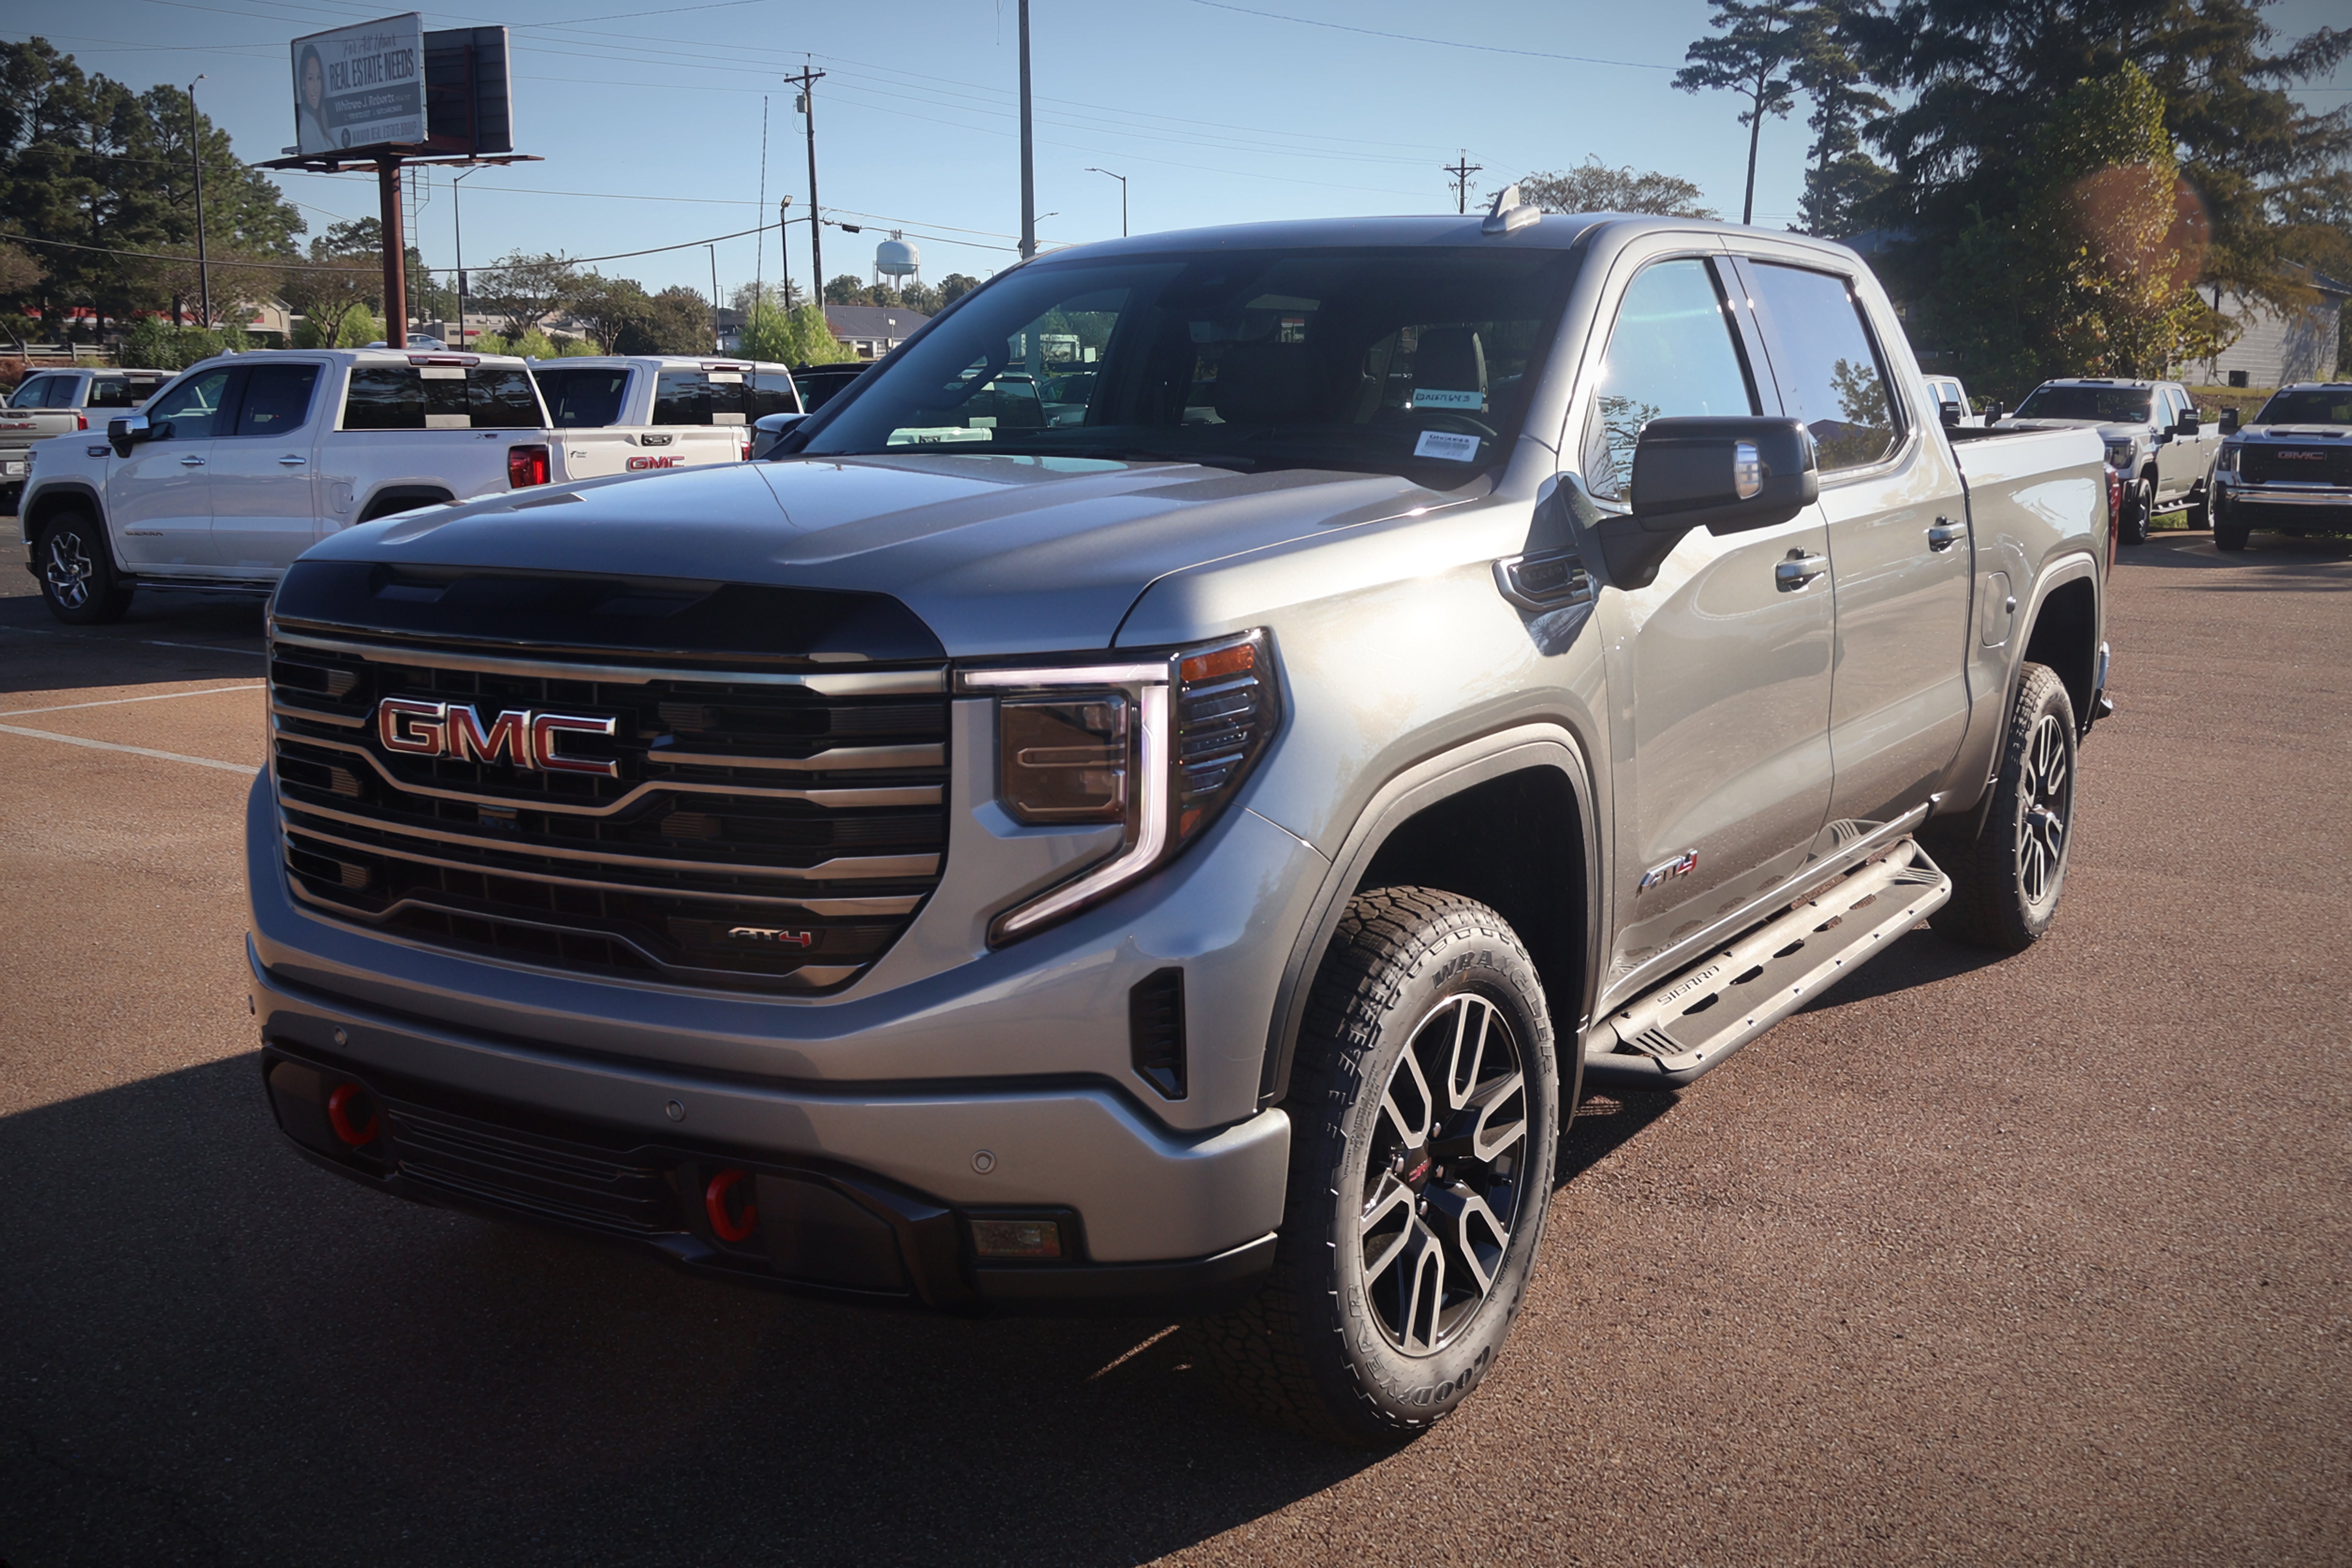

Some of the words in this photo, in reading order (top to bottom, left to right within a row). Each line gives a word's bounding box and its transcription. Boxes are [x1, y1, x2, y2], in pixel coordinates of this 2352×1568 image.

[343, 40, 357, 57] For
[360, 35, 372, 54] All
[329, 60, 351, 91] REAL
[352, 53, 383, 87] ESTATE
[384, 48, 414, 81] NEEDS
[626, 456, 684, 472] GMC
[2278, 451, 2324, 460] GMC
[379, 697, 618, 778] GMC
[1636, 849, 1698, 896] AT4
[728, 927, 811, 947] AT4
[1657, 965, 1720, 1006] SIERRA
[1431, 949, 1553, 1076] WRANGLER
[1347, 1284, 1491, 1406] GOODYEAR
